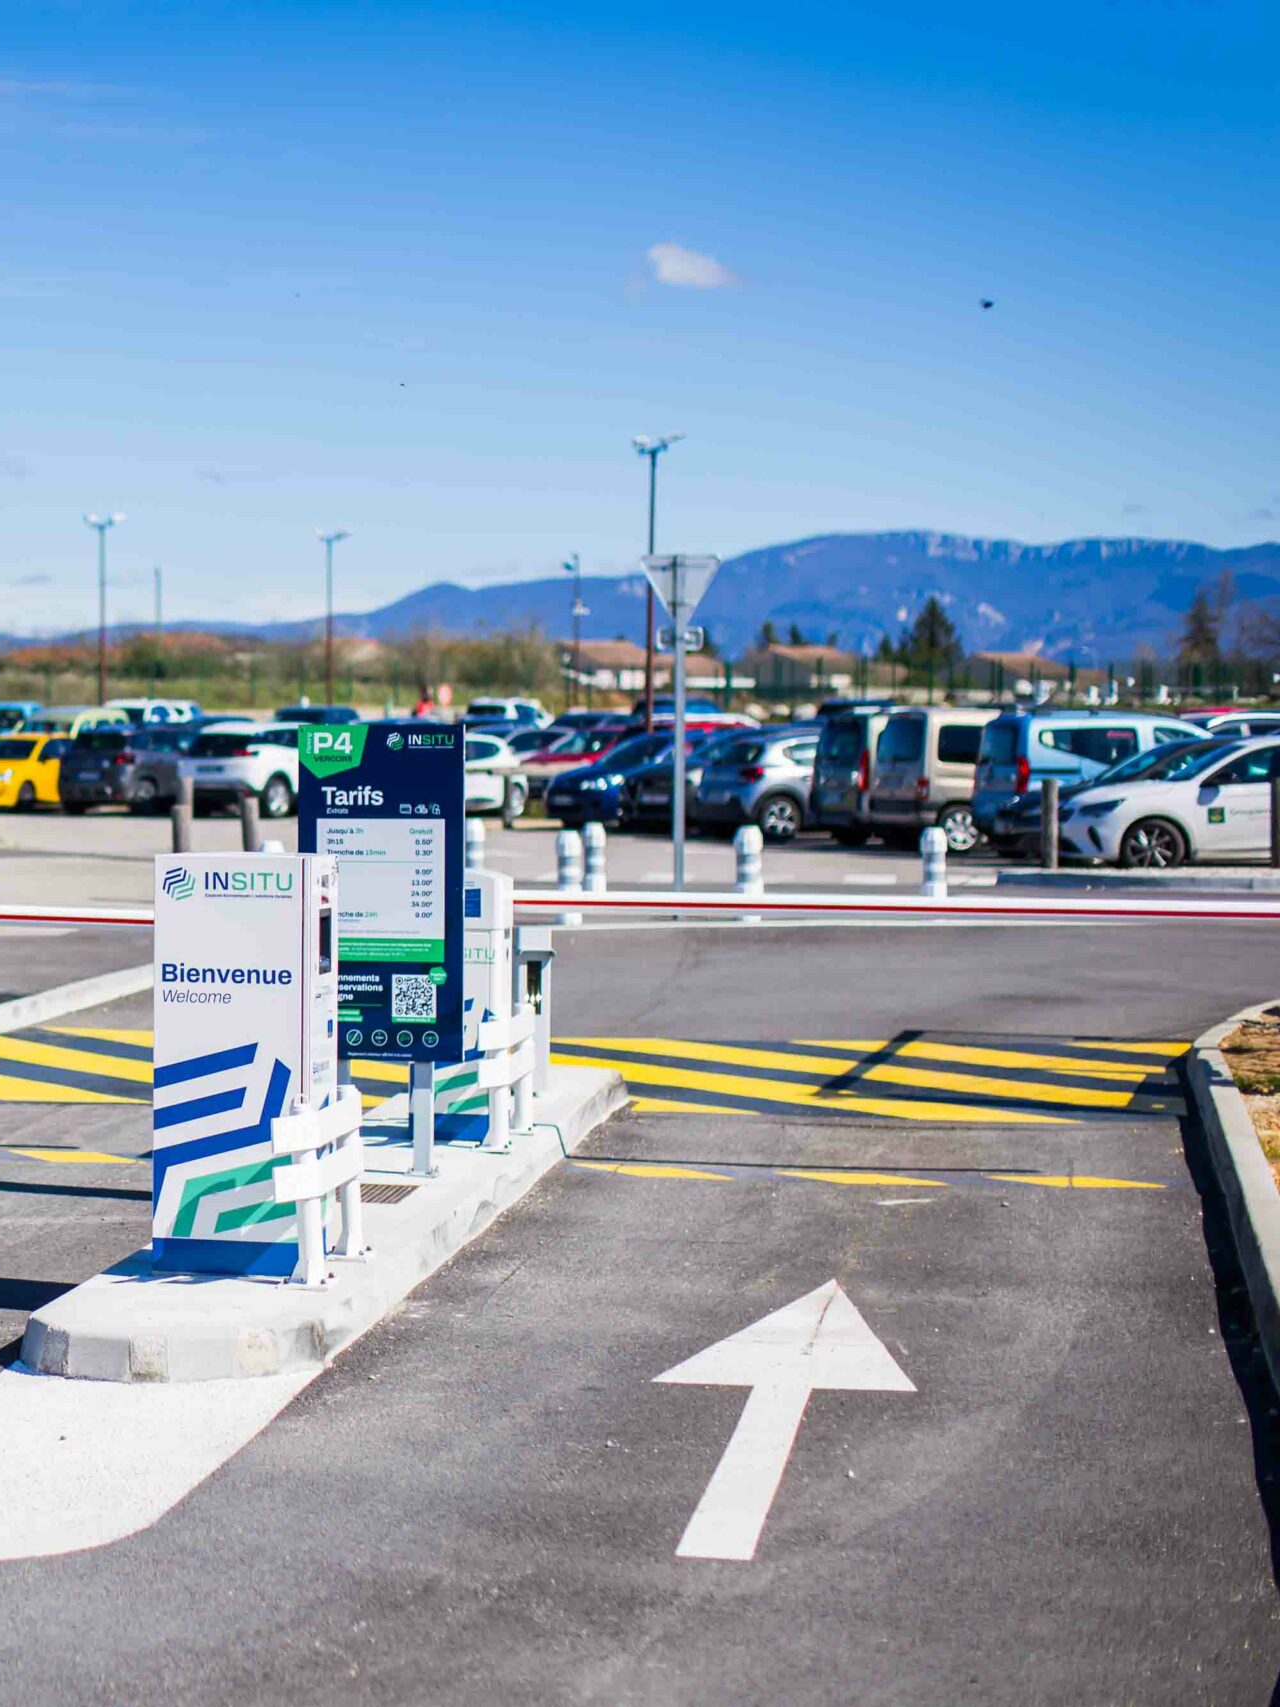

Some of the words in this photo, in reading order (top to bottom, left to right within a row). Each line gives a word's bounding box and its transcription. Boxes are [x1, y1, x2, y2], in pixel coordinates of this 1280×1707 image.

[313, 732, 353, 754] P4
[408, 733, 455, 746] INSITU
[321, 785, 384, 806] Tarifs
[204, 871, 293, 891] INSITU
[464, 947, 496, 960] ITU
[161, 963, 293, 985] Bienvenue
[338, 974, 380, 982] nnements
[338, 983, 383, 992] servations
[162, 989, 232, 1004] Welcome
